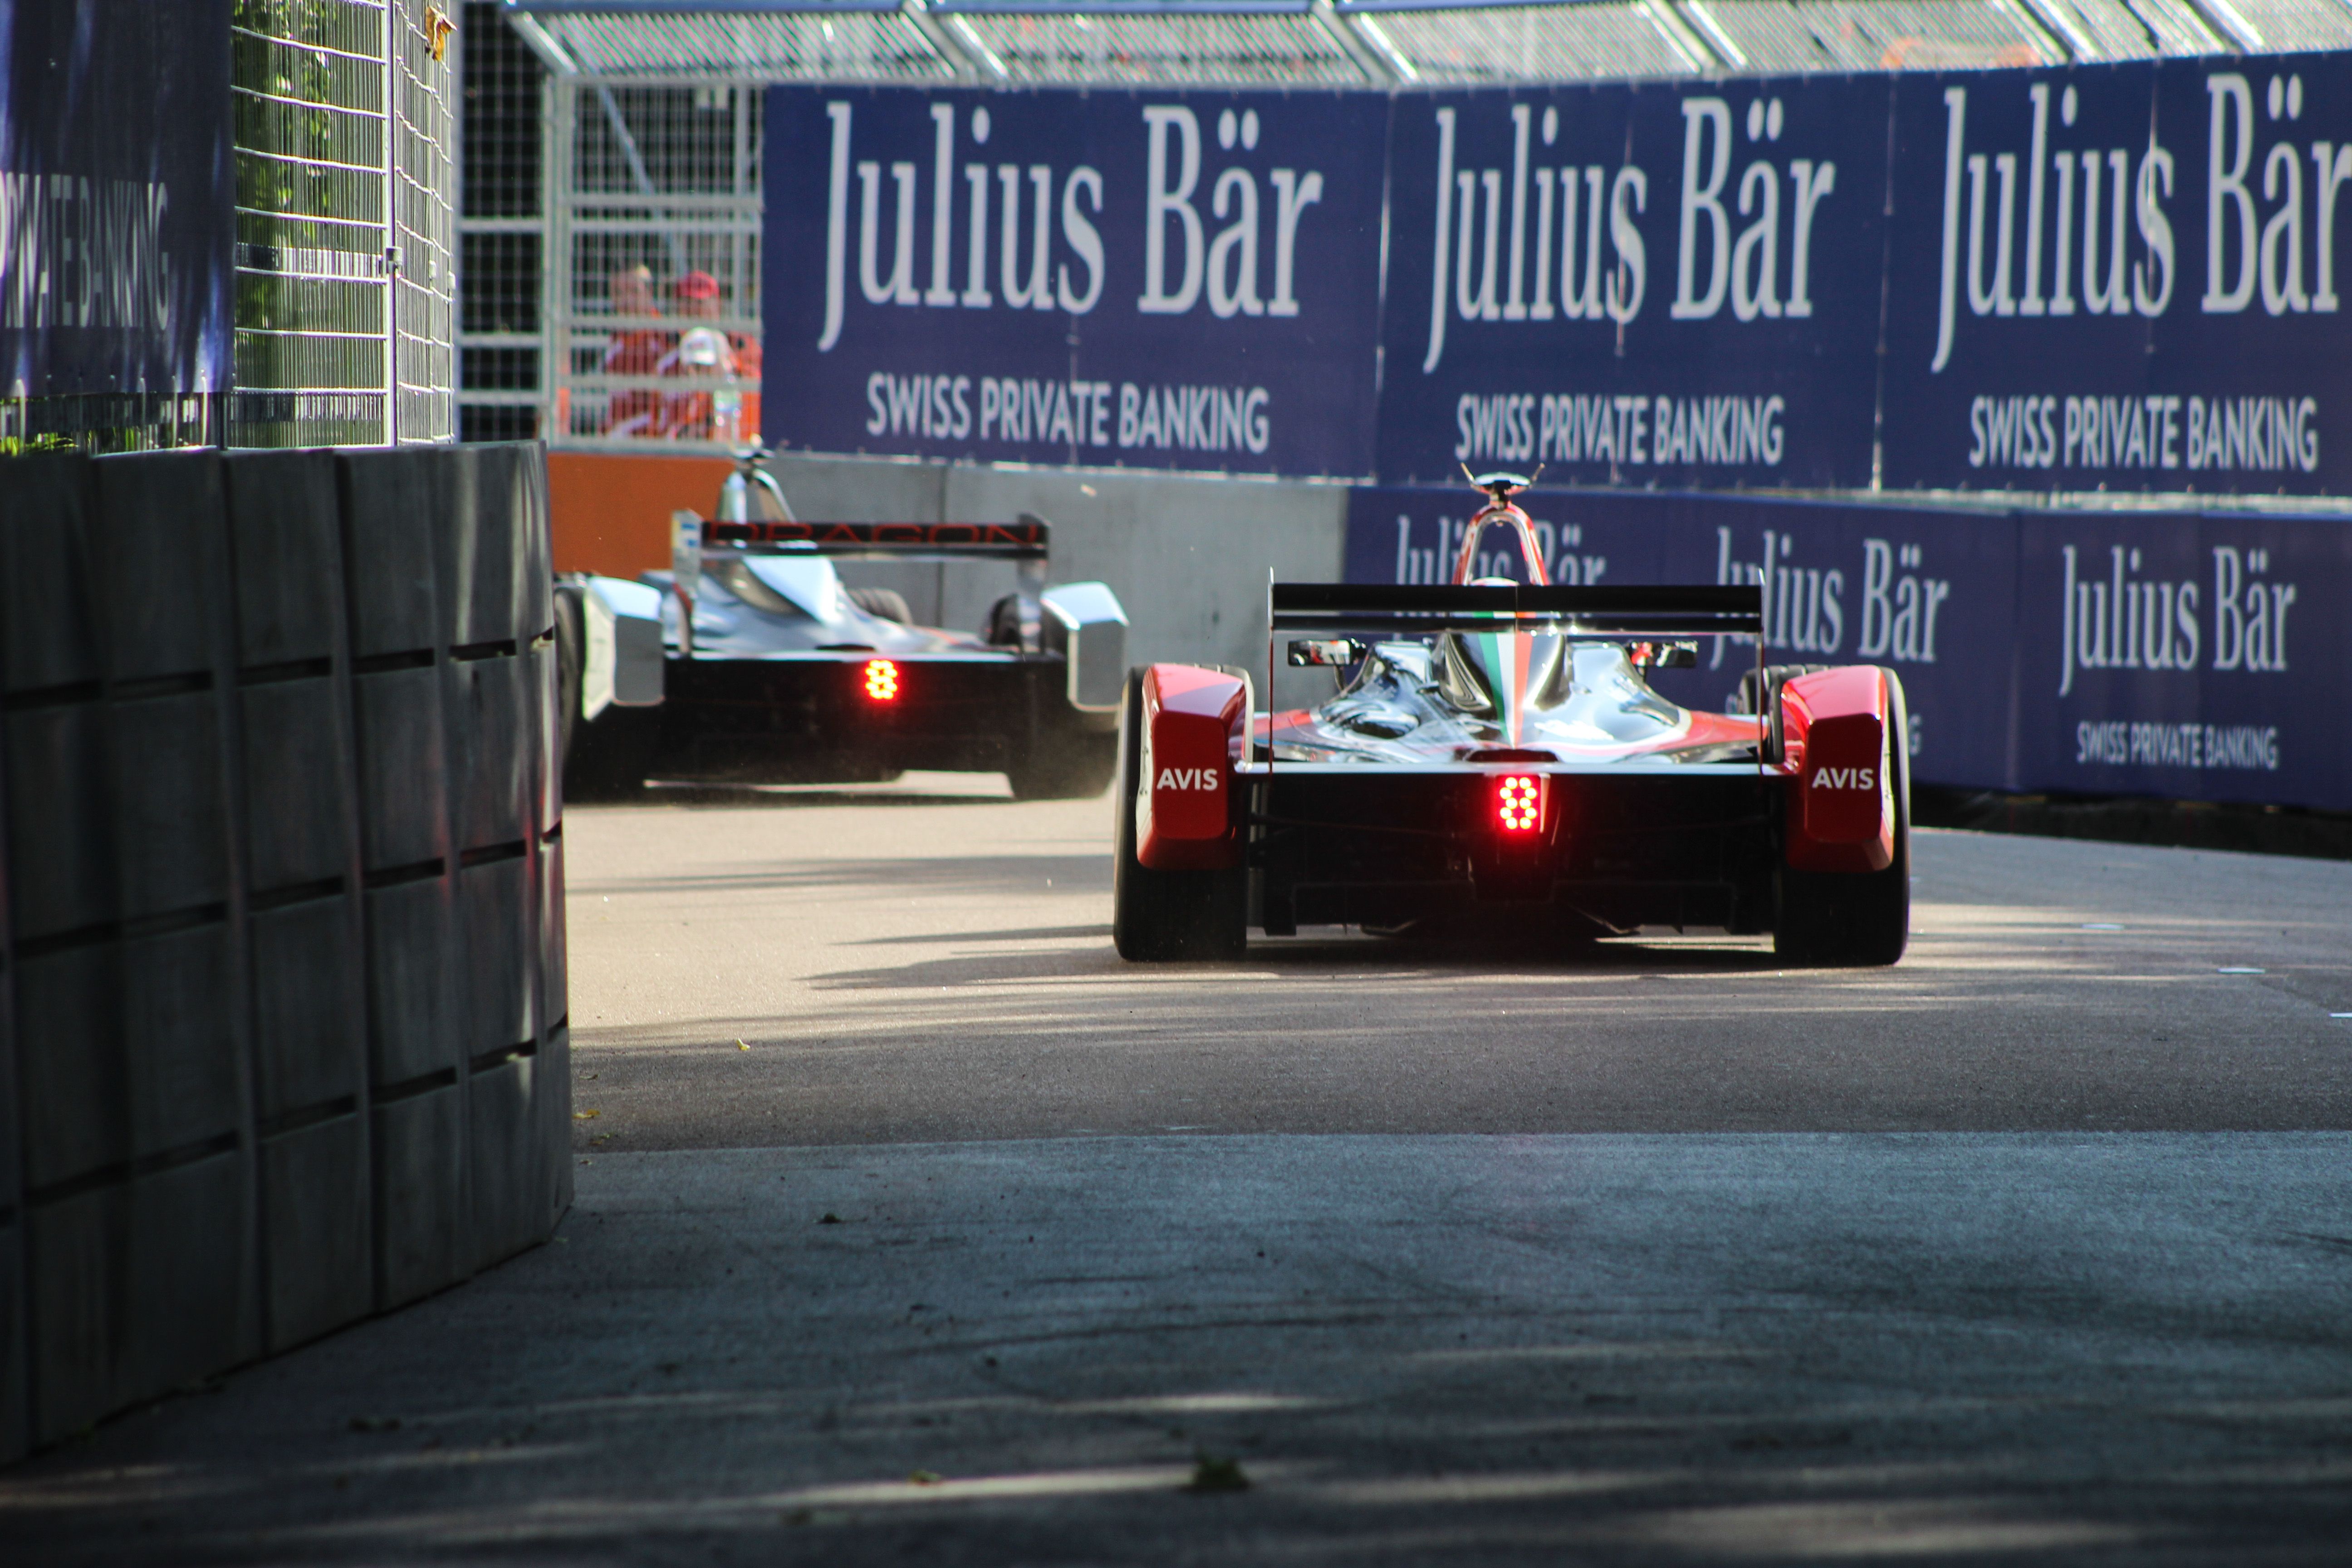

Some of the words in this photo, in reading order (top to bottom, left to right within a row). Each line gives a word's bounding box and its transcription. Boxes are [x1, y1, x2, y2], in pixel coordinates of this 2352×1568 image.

[78, 175, 170, 331] BANKING
[818, 101, 1105, 352] Julius
[1137, 105, 1324, 318] Bär
[1423, 103, 1647, 373] Julius
[1670, 97, 1836, 322] Bär
[1931, 83, 2175, 373] Julius
[2201, 73, 2352, 317] Bär
[866, 372, 972, 440] SWISS
[980, 377, 1112, 446] PRIVATE
[1118, 382, 1270, 454] BANKING
[1455, 393, 1535, 462] SWISS
[1539, 394, 1649, 465] PRIVATE
[1653, 395, 1785, 465] BANKING
[1969, 395, 2057, 469] SWISS
[2064, 395, 2181, 469] PRIVATE
[2187, 395, 2318, 472] BANKING
[710, 522, 1038, 545] DRAGON
[1858, 538, 1950, 662] Bär
[2059, 544, 2200, 696] Julius
[2213, 545, 2296, 671] Bär
[1156, 768, 1218, 791] AVIS
[1812, 767, 1874, 790] AVIS
[2077, 720, 2128, 764] SWISS
[2131, 722, 2202, 767] PRIVATE
[2205, 724, 2278, 770] BANKING
